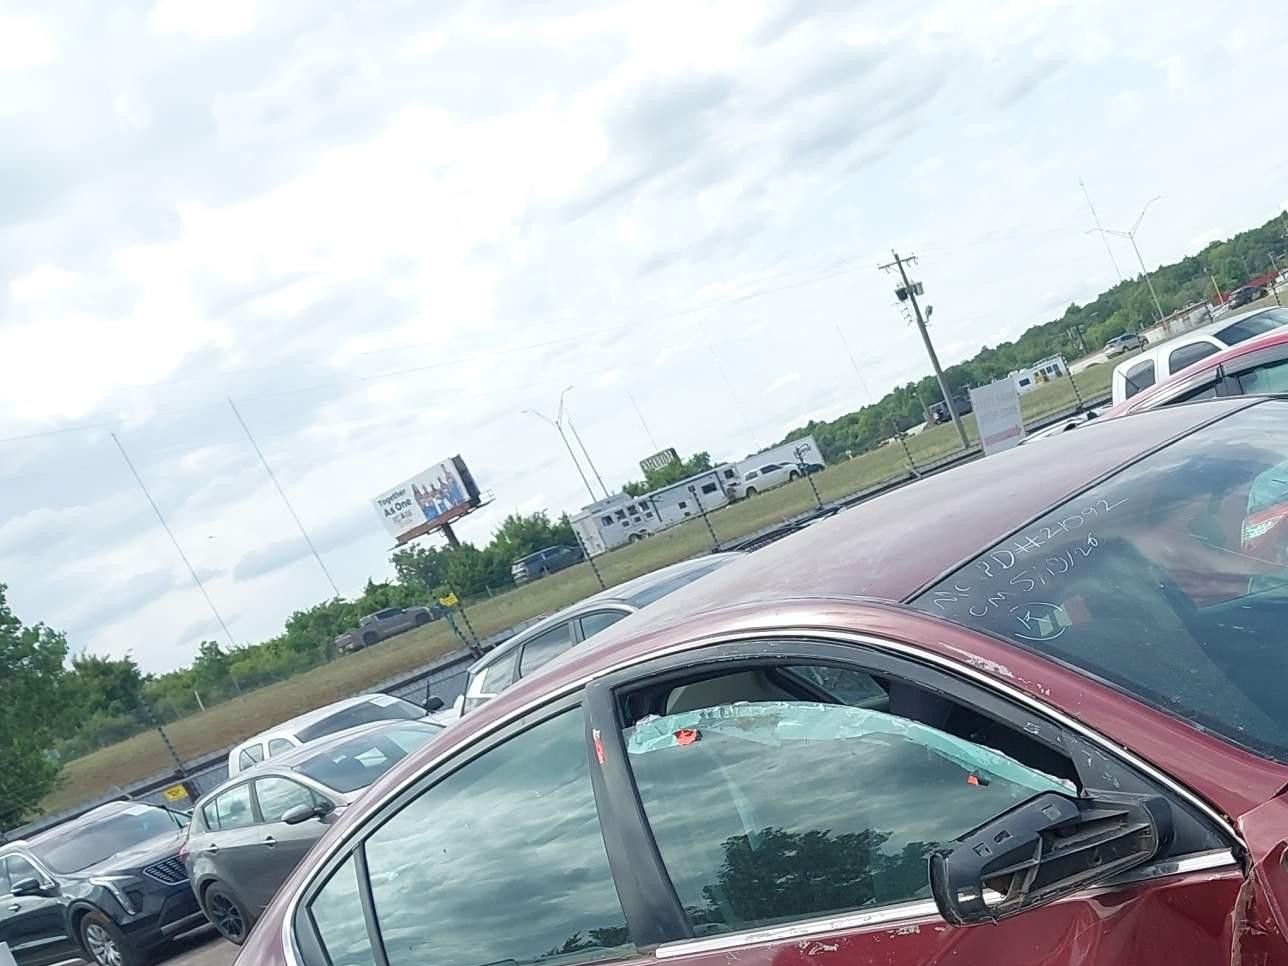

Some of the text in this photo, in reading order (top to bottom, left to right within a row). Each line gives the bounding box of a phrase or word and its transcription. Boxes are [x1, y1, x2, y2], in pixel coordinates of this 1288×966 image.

[378, 489, 406, 506] Together
[384, 507, 396, 518] As
[395, 498, 412, 512] One
